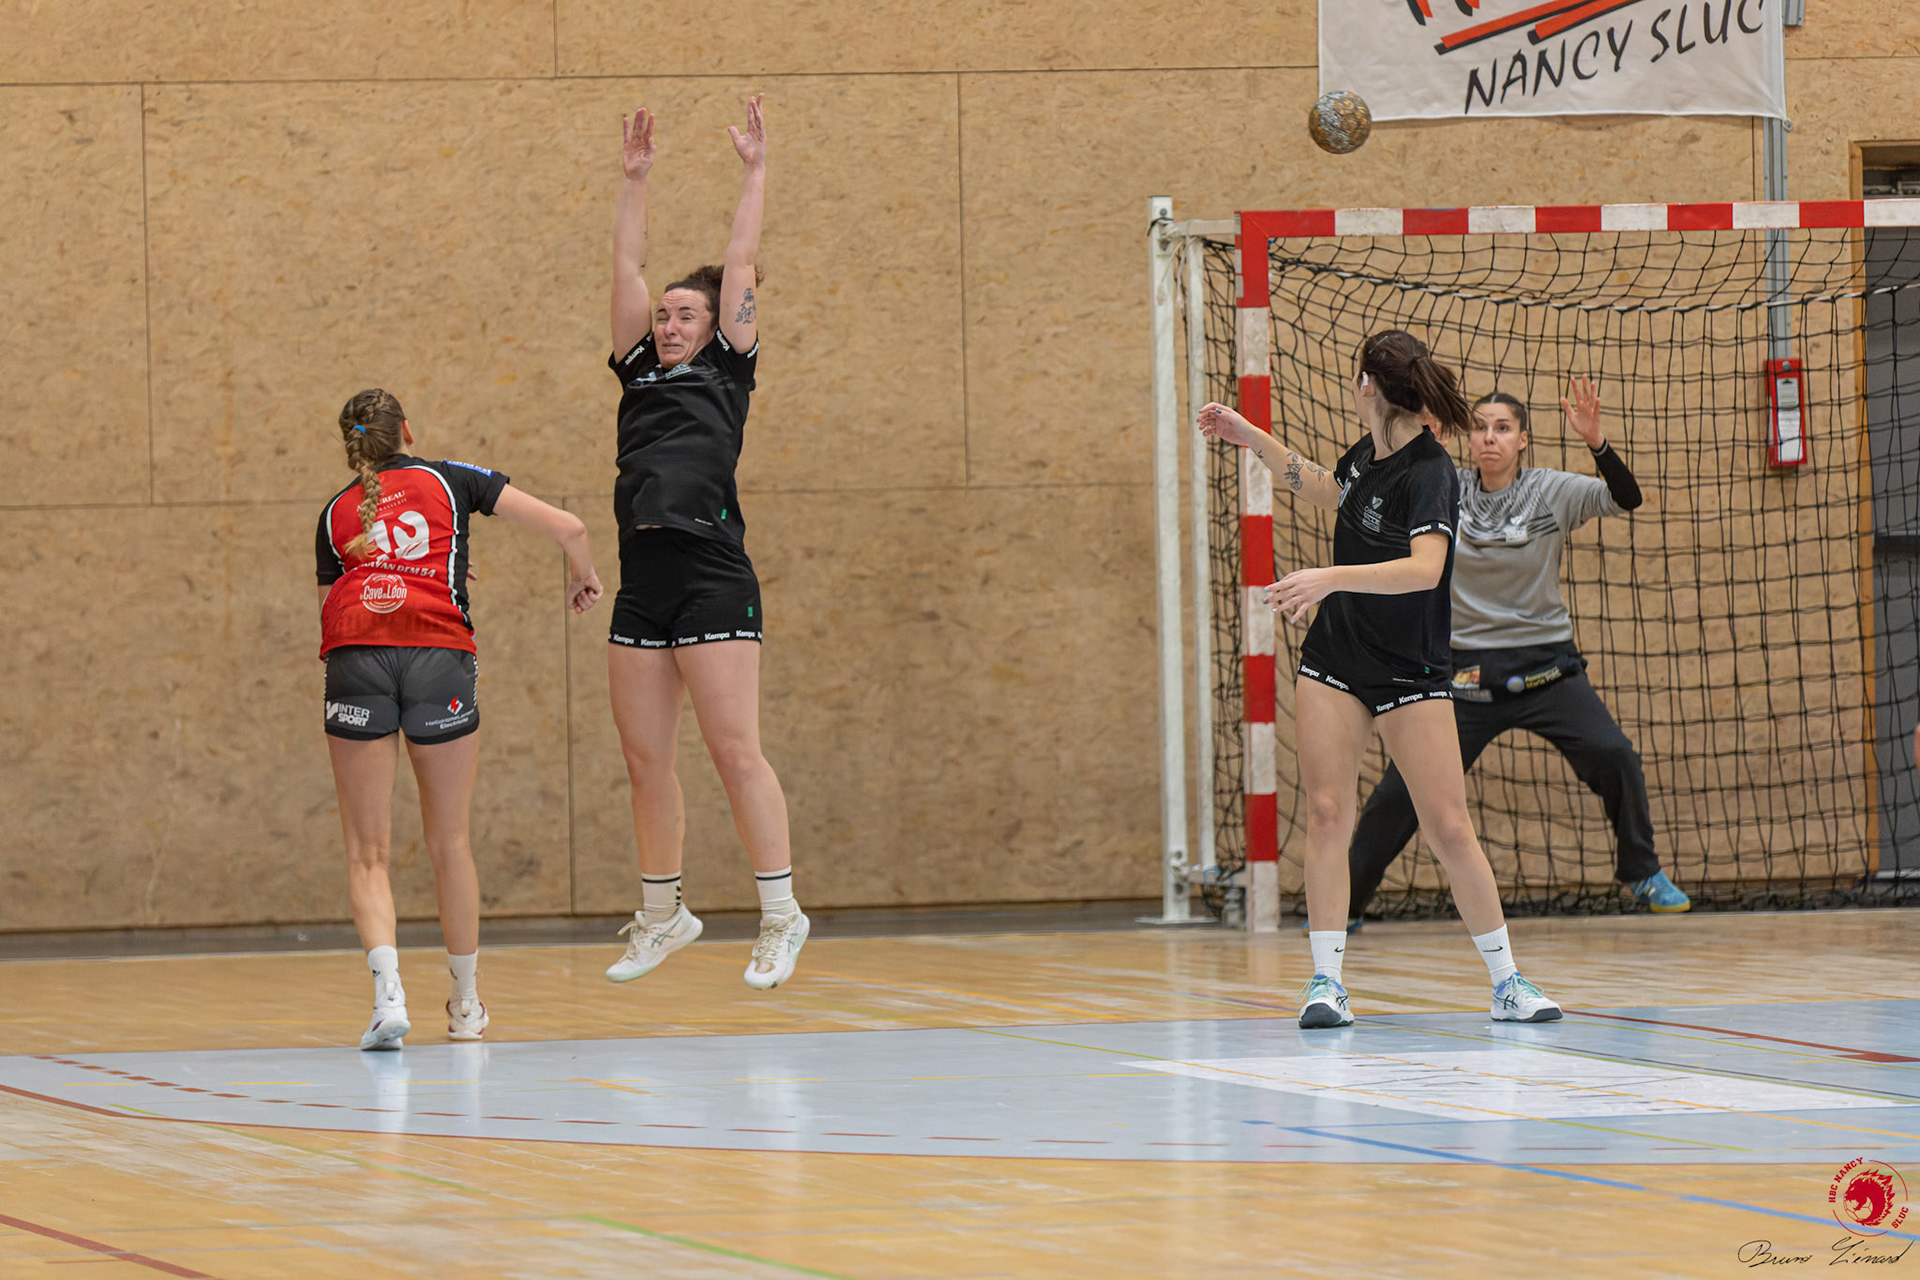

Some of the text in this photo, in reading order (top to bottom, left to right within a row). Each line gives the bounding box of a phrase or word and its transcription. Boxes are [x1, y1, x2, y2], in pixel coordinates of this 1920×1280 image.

[1464, 0, 1764, 114] NANCY SLUC
[363, 584, 383, 600] Cave
[387, 584, 408, 599] Léon
[613, 633, 635, 645] Kempa
[678, 635, 698, 645] Kempa
[704, 631, 730, 641] Kempa
[735, 629, 756, 638] Kempa
[640, 638, 667, 648] Kempa
[1300, 664, 1320, 678] Kempa
[1325, 674, 1350, 691] Kempa
[1398, 692, 1424, 705] Kempa
[338, 702, 370, 718] INTER
[1376, 701, 1395, 713] Kempa
[337, 713, 369, 727] SPORT
